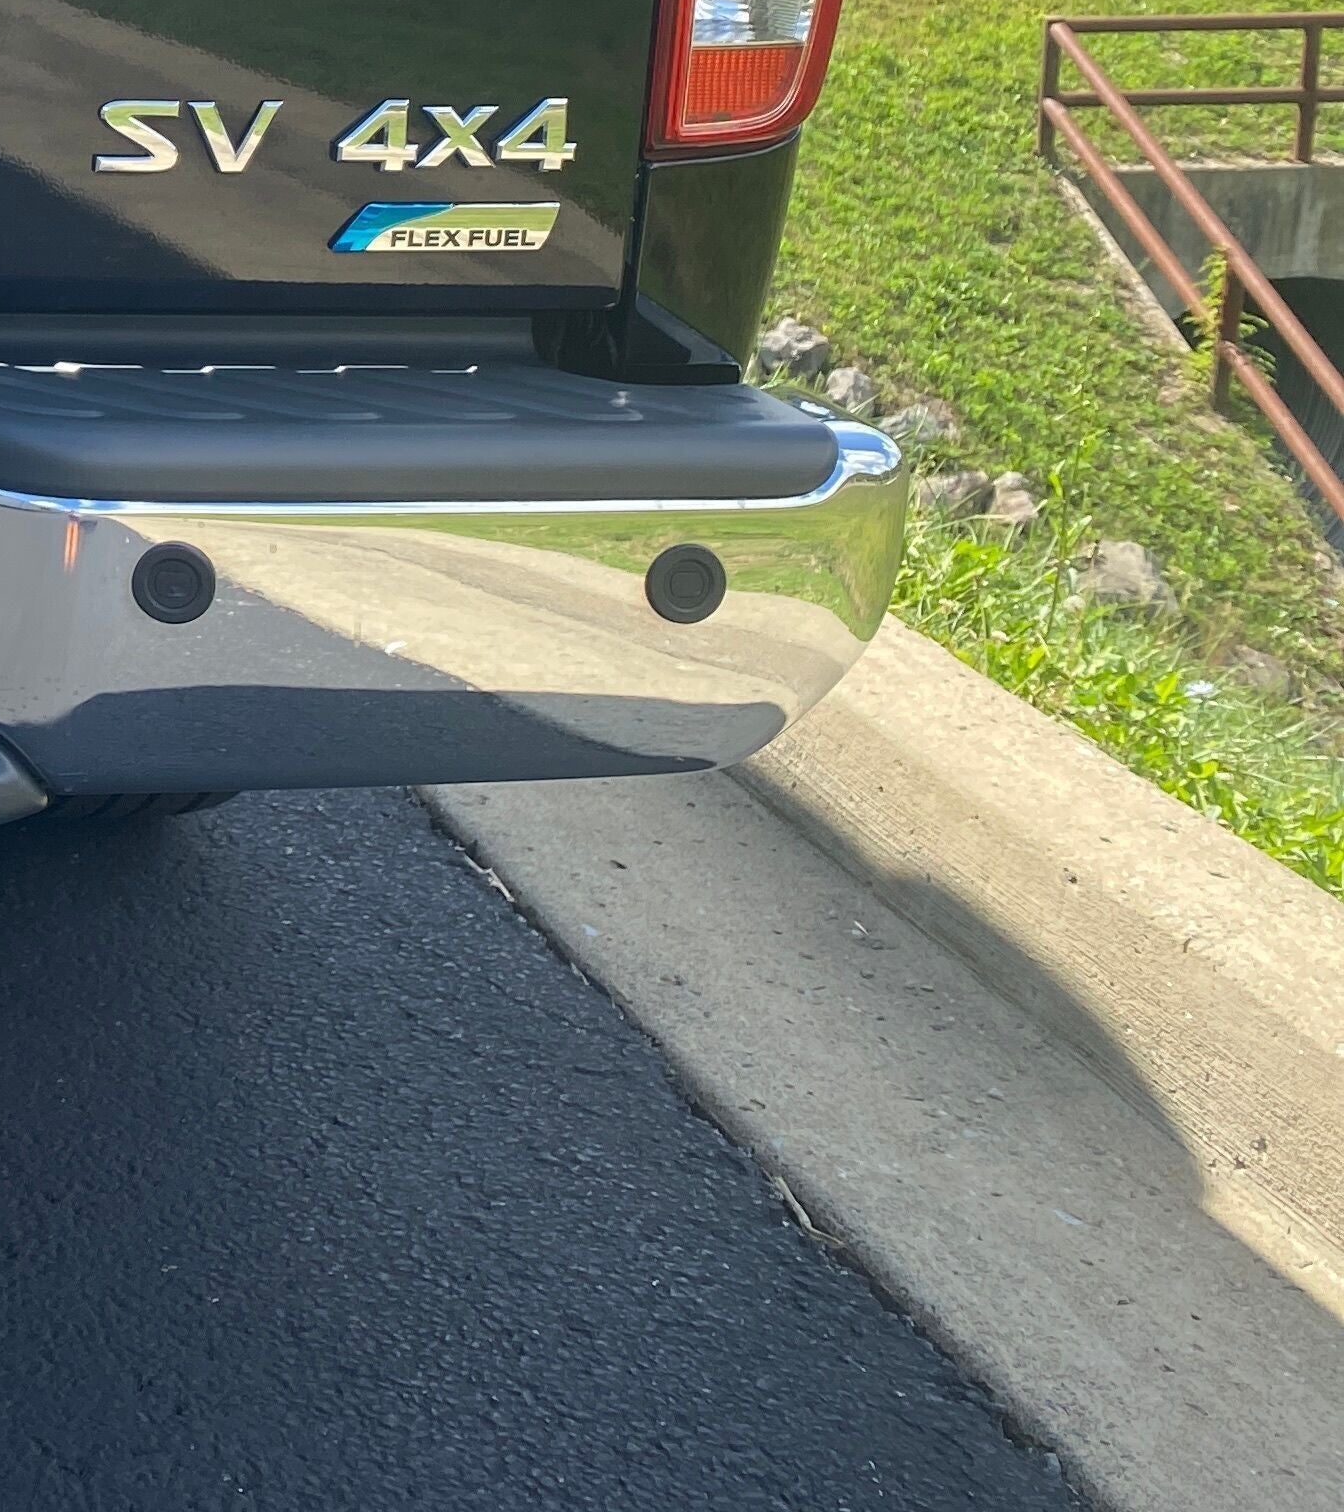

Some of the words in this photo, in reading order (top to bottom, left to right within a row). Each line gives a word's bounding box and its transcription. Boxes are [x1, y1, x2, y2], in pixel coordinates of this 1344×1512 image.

[92, 99, 285, 173] SV
[390, 229, 461, 248] FLEX
[467, 229, 537, 248] FUEL
